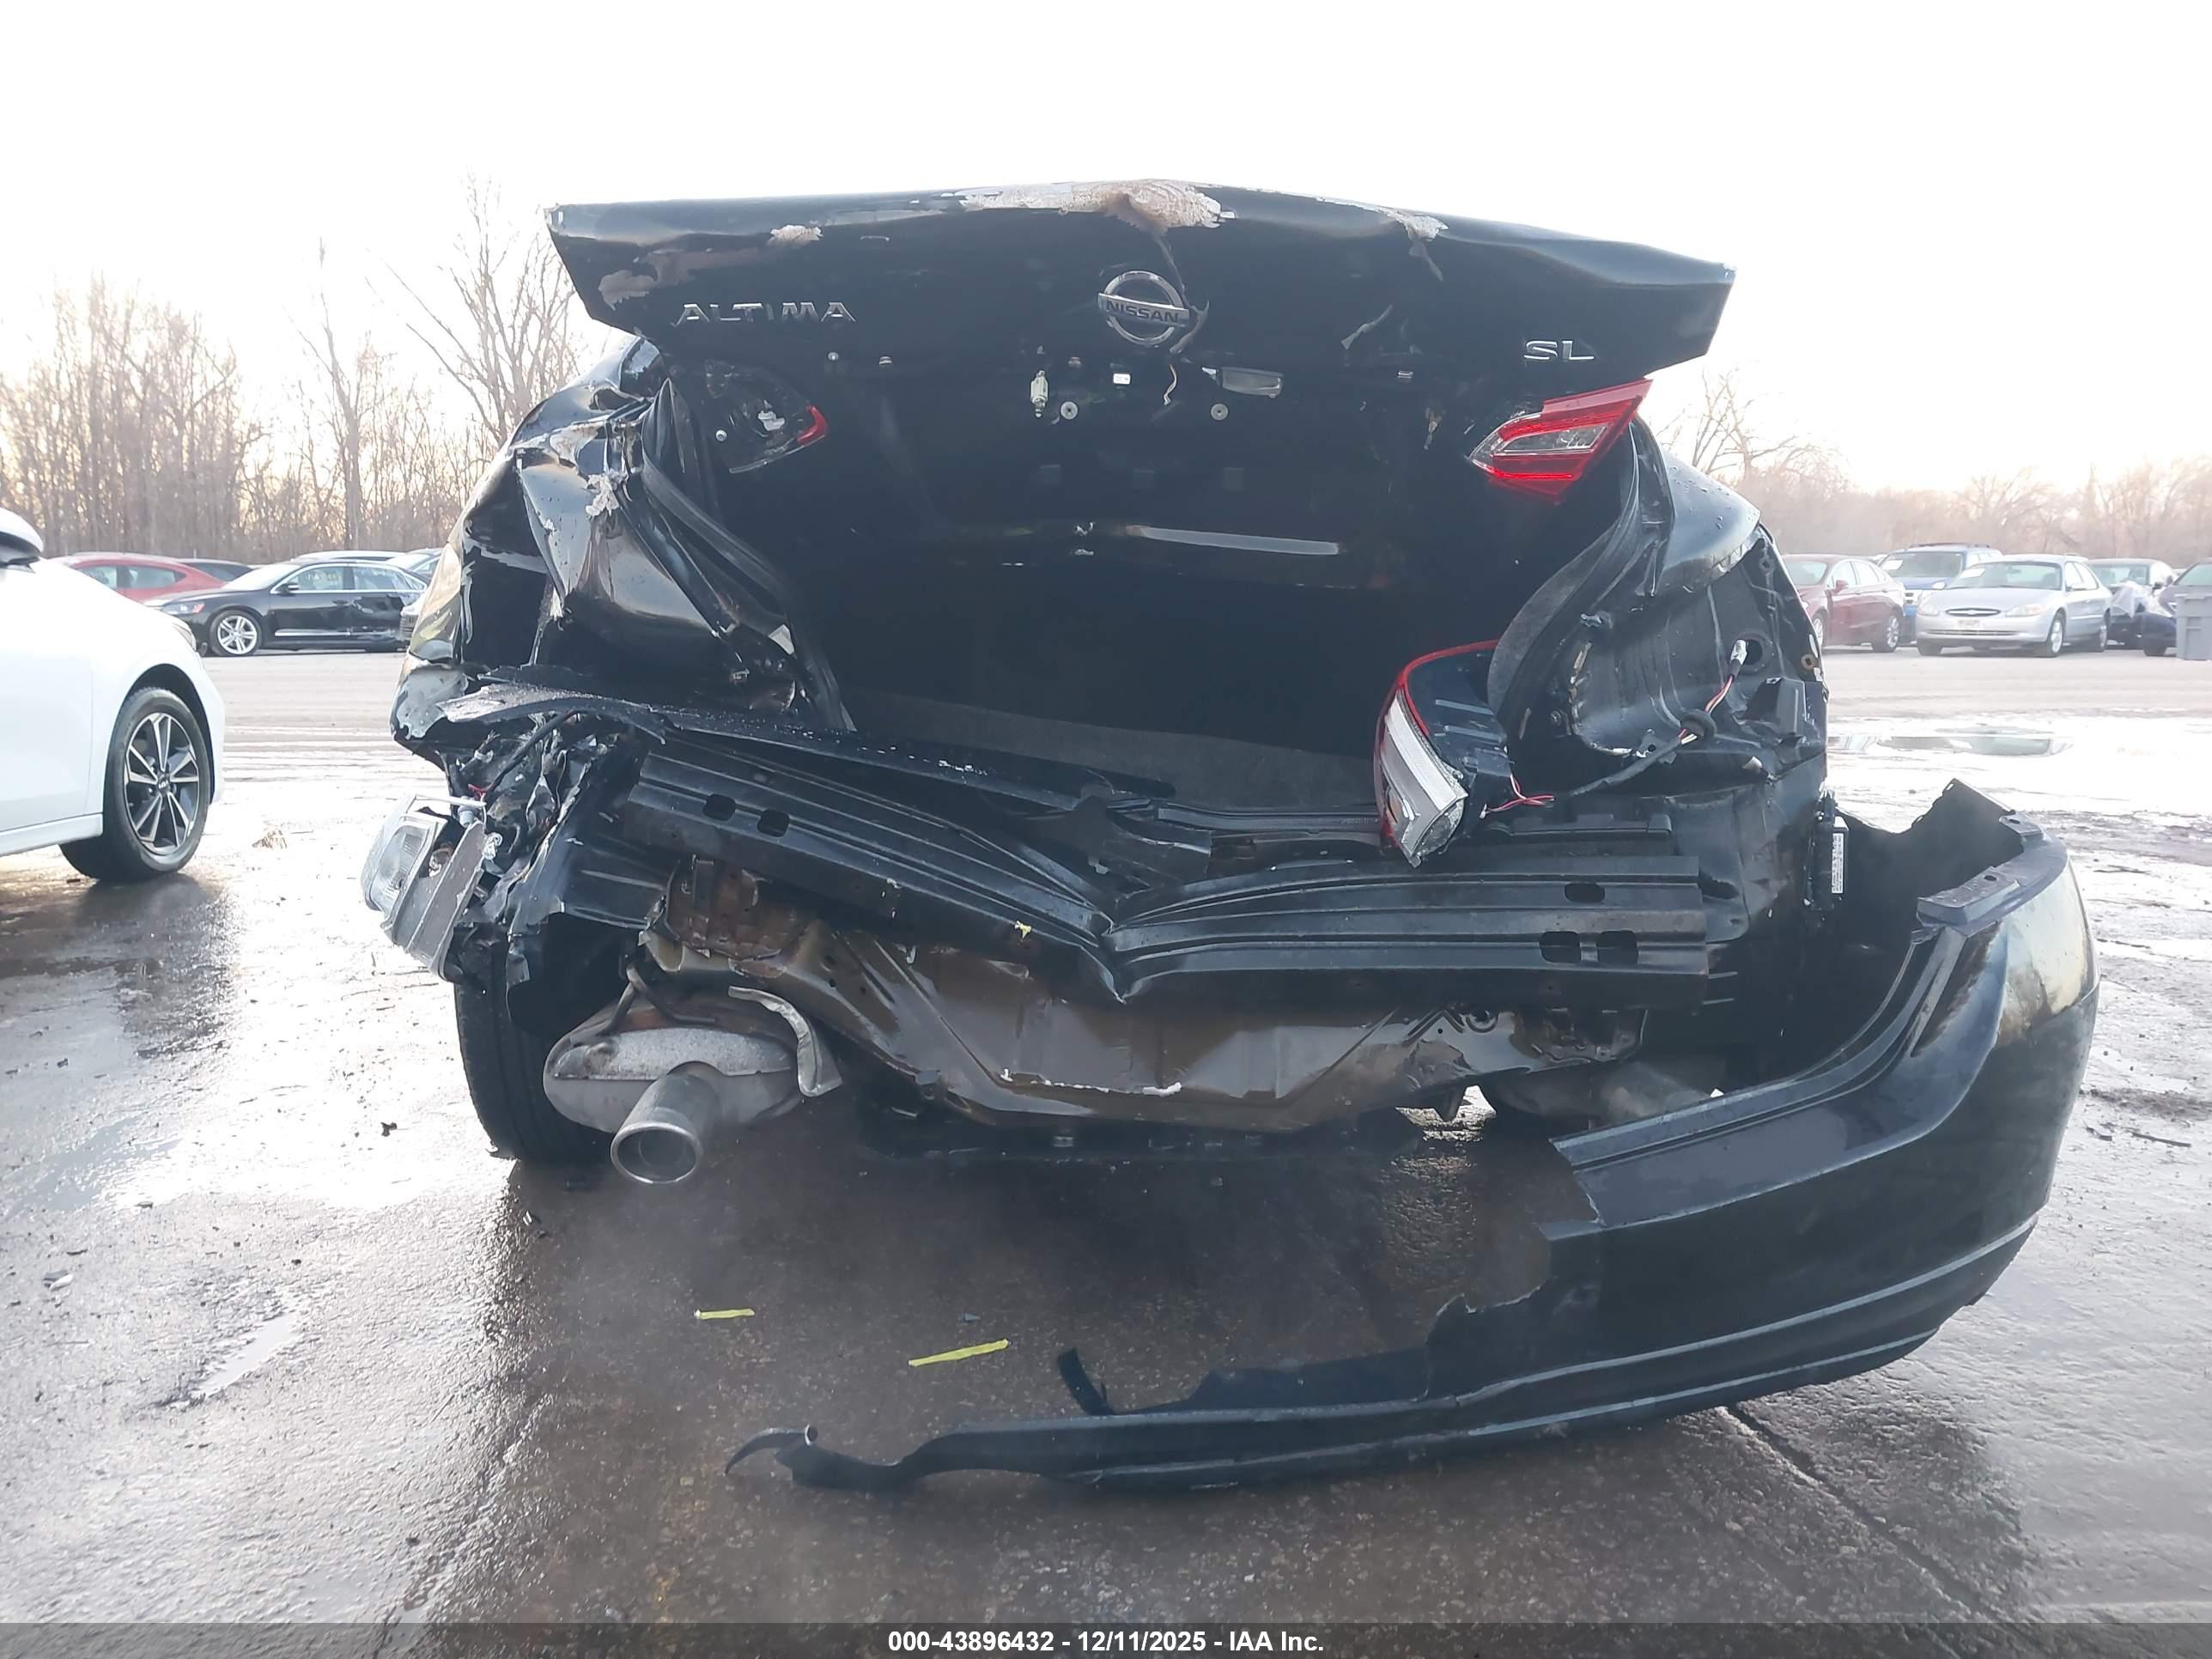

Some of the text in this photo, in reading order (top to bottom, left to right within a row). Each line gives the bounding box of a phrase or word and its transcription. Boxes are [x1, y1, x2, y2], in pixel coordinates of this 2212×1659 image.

[676, 301, 856, 325] ALTIMA
[1105, 299, 1179, 324] NISSAN
[1523, 340, 1595, 361] SL
